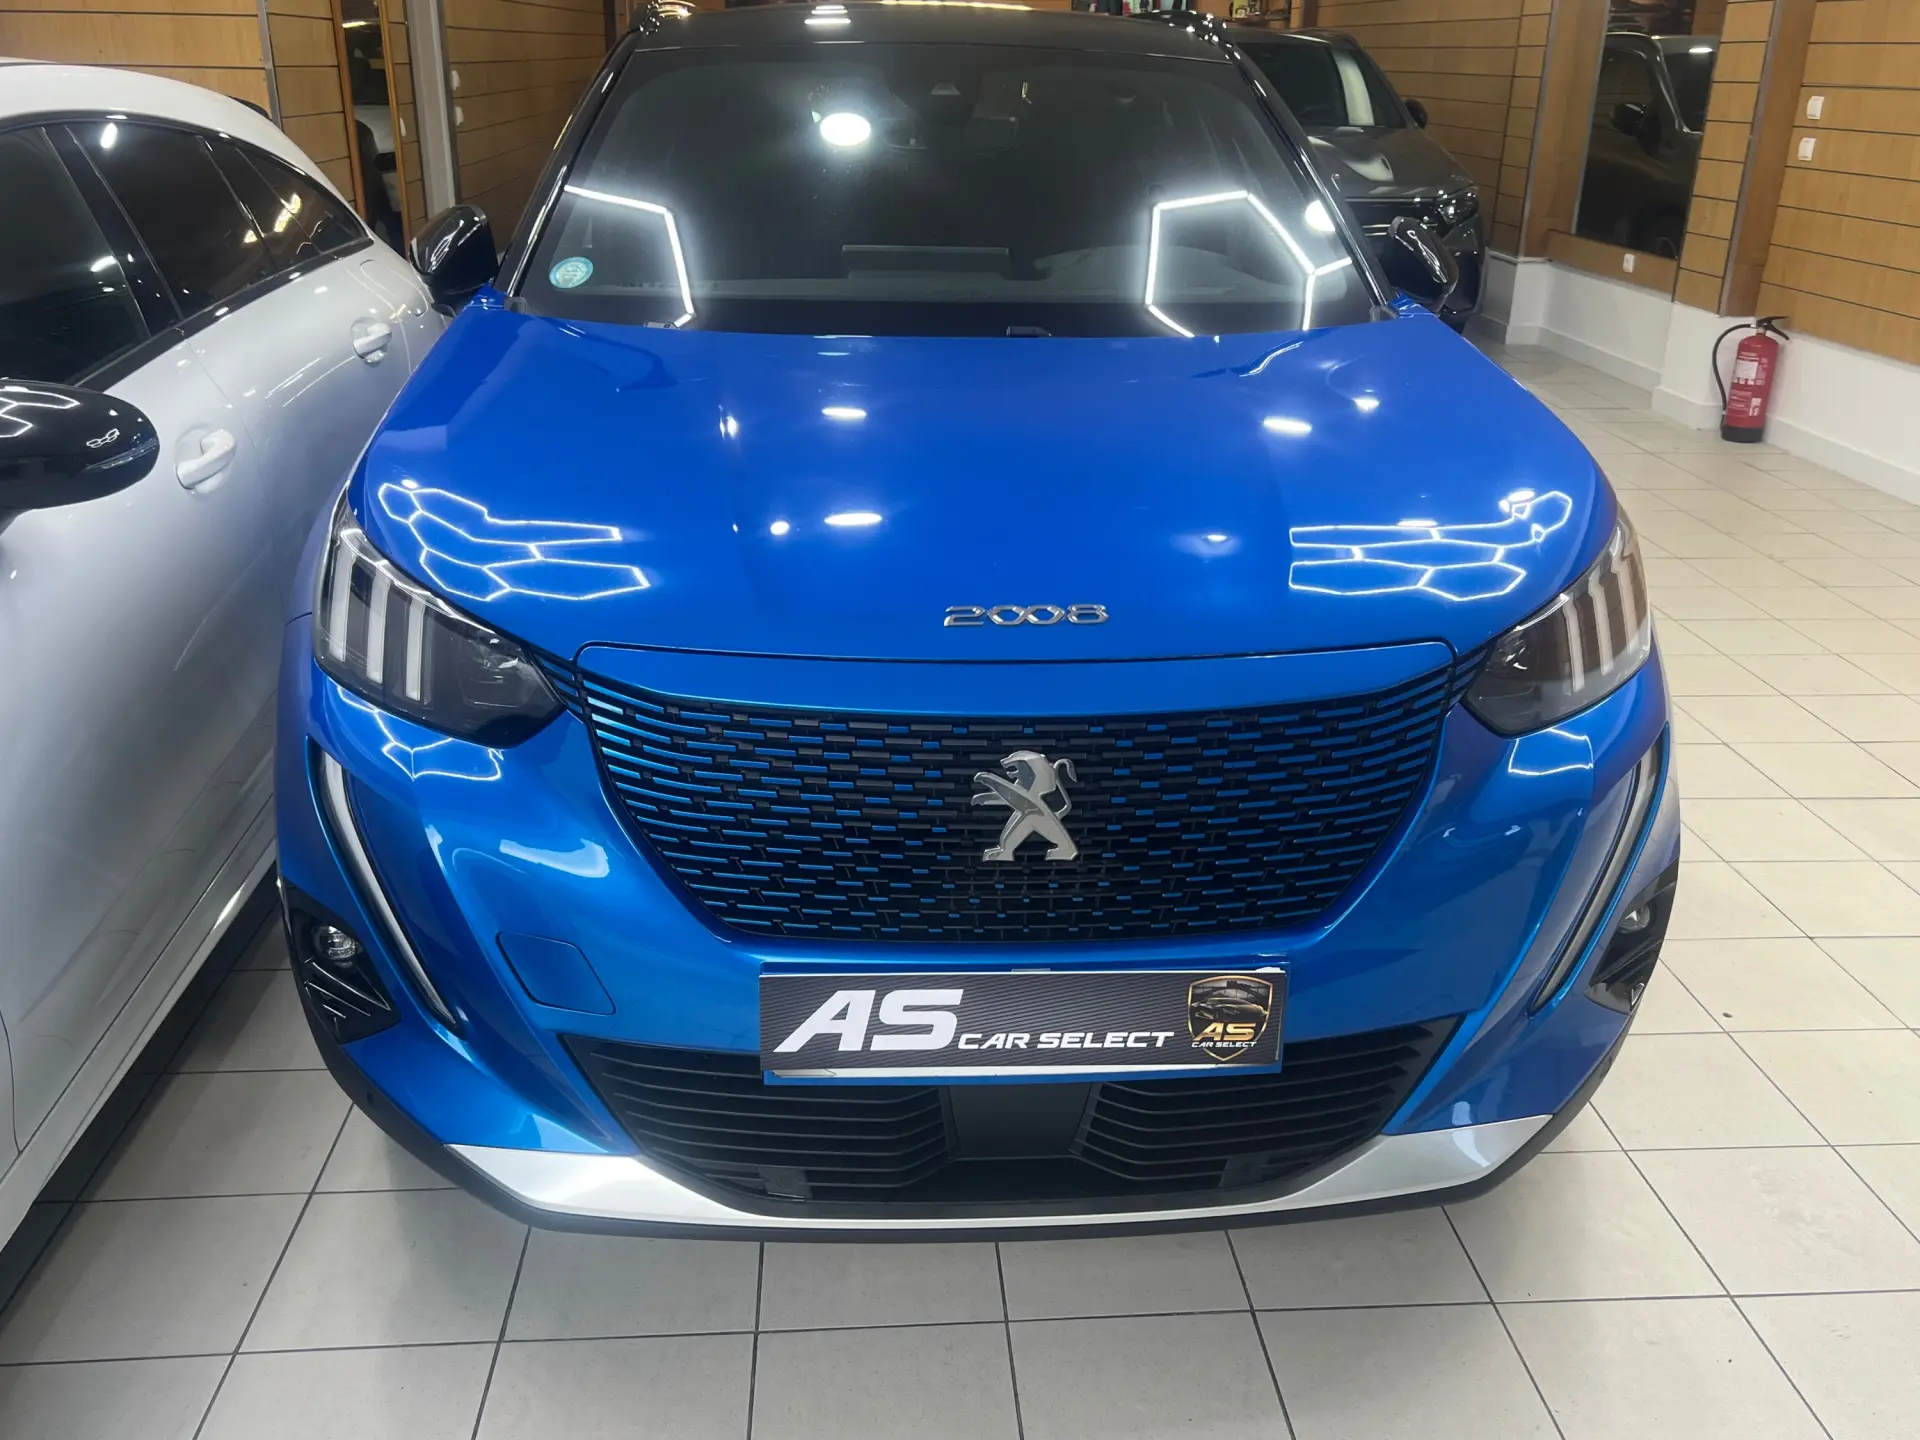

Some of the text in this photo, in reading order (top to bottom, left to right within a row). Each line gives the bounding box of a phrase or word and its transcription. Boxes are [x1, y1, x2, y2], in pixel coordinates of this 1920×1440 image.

[943, 604, 1109, 626] 2008
[773, 989, 1174, 1053] AS CAR SELECT
[1193, 1022, 1256, 1041] AS
